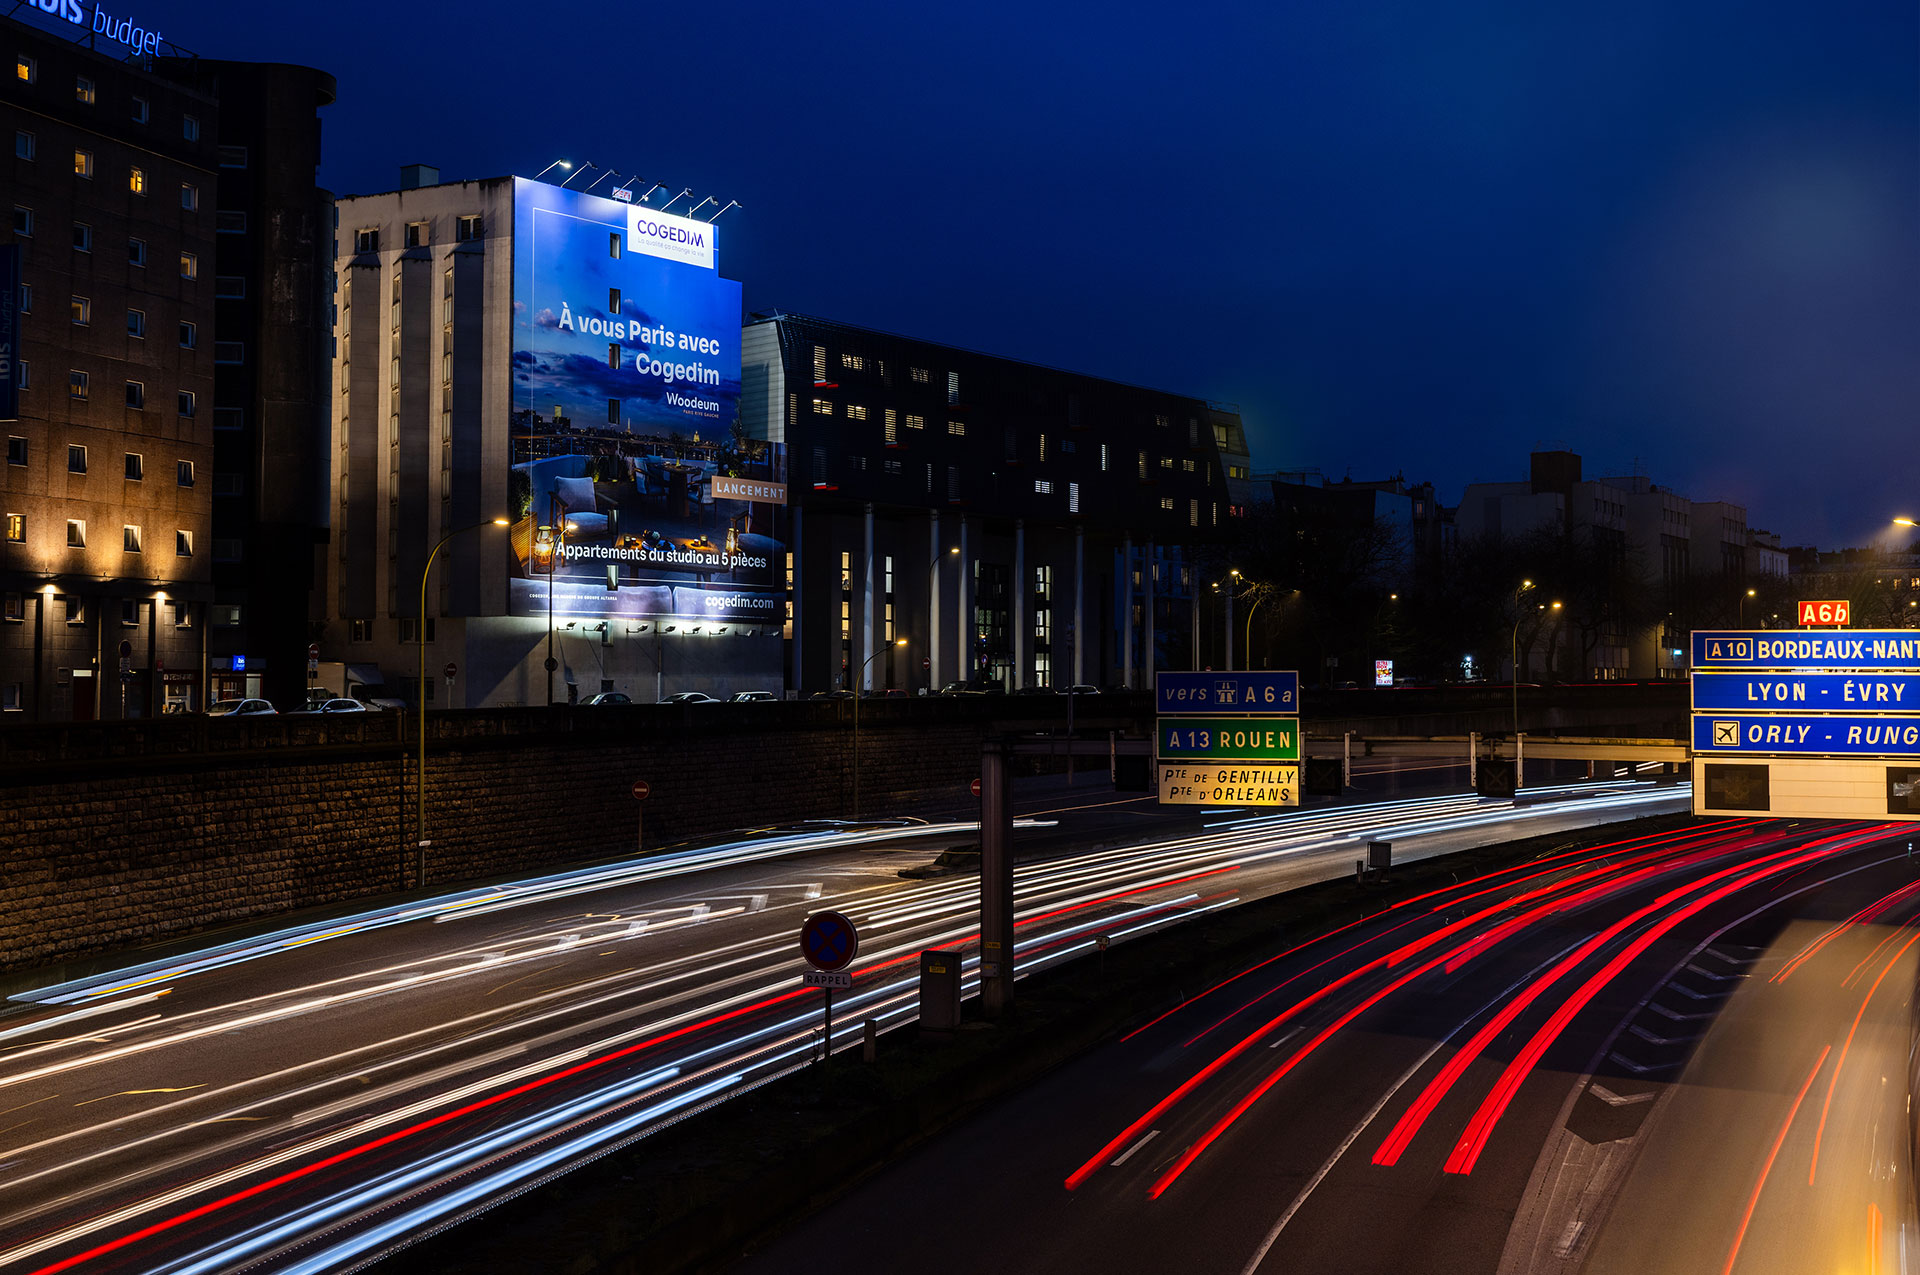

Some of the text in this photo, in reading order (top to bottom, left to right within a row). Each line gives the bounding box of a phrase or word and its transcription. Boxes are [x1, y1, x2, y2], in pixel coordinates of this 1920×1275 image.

[27, 0, 163, 57] is budget
[637, 220, 704, 248] COGEDIM
[558, 301, 720, 356] À vous Paris avec
[635, 352, 720, 386] Cogedim
[666, 391, 720, 412] Woodeum
[716, 481, 785, 499] LANCEMENT
[555, 541, 767, 570] Appartements du studio au 5 pièces
[705, 594, 774, 610] cogedim.com
[1803, 604, 1847, 623] A6b
[1166, 687, 1207, 701] vers
[1747, 682, 1806, 702] LYON
[1843, 679, 1906, 702] ÉVRY
[1220, 731, 1290, 748] ROUEN
[1748, 724, 1811, 744] ORLY
[1846, 725, 1919, 746] RUNG
[1194, 774, 1208, 783] DE
[1217, 770, 1295, 784] GENTILLY
[807, 975, 848, 985] RAPPEL
